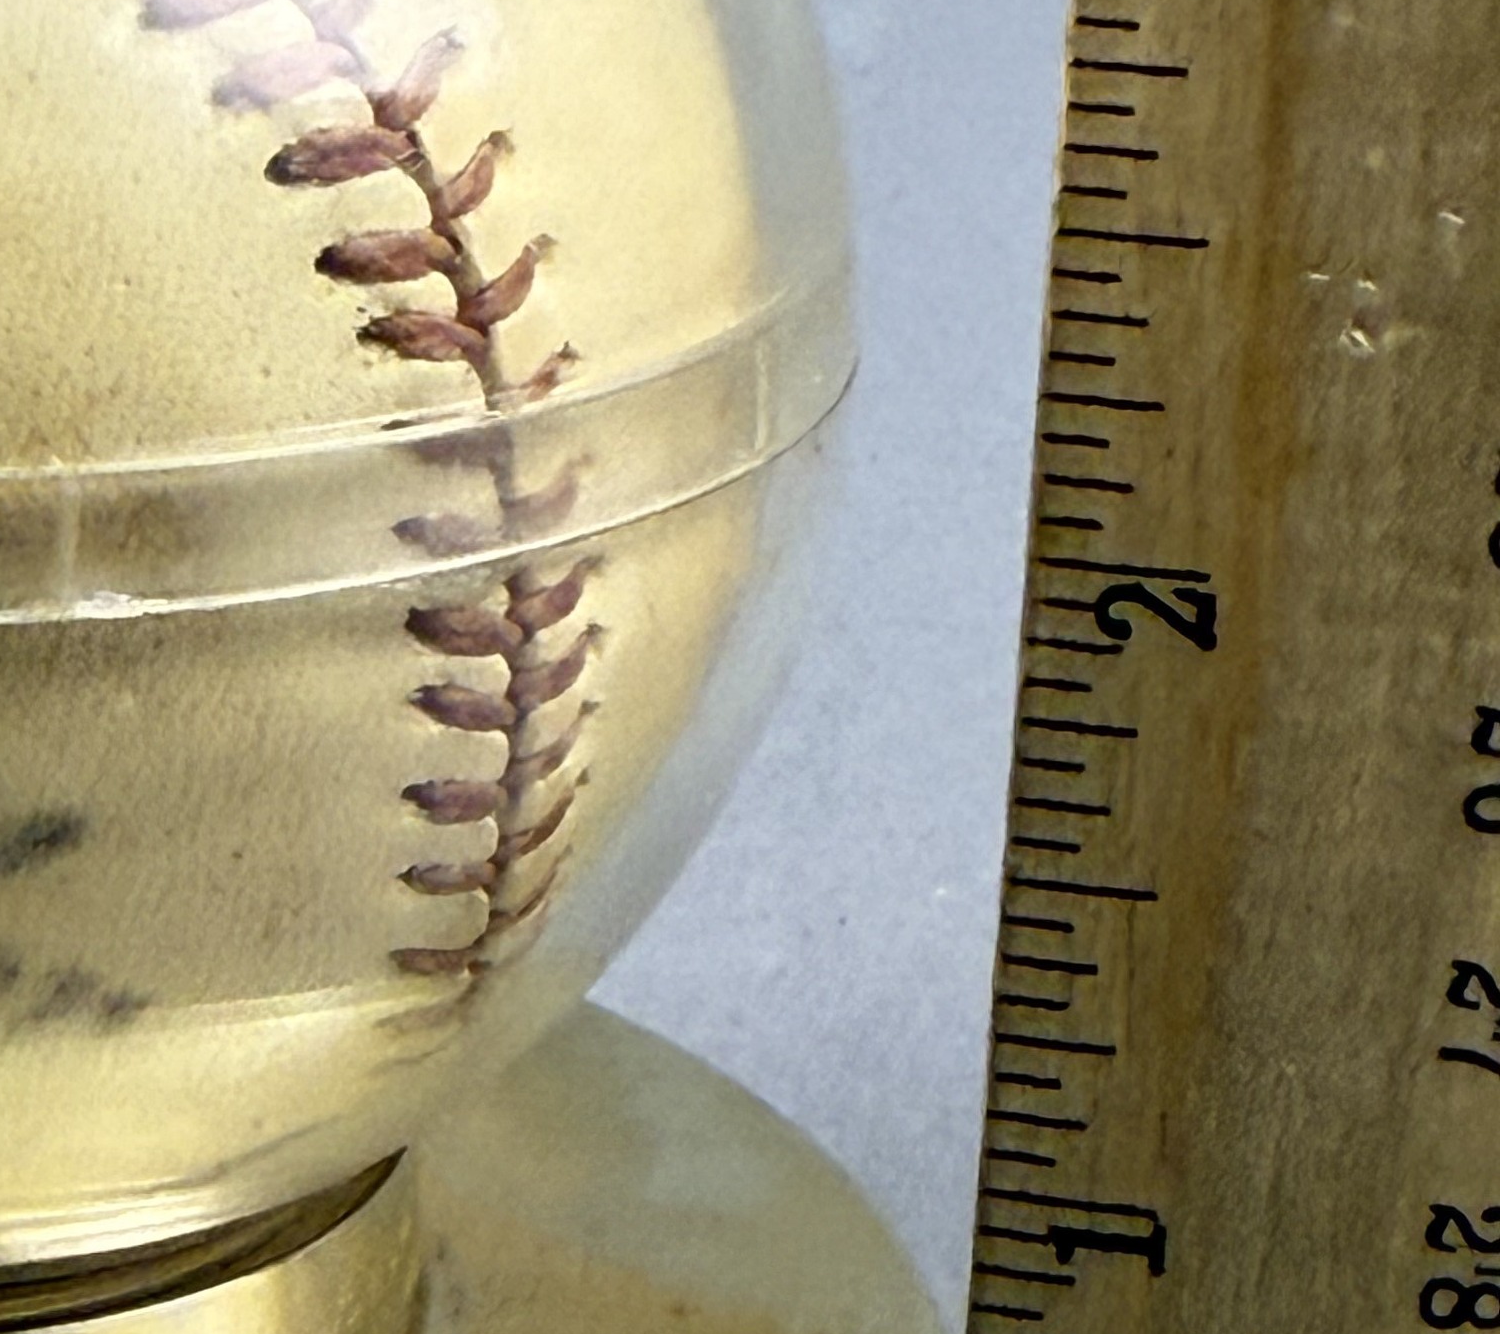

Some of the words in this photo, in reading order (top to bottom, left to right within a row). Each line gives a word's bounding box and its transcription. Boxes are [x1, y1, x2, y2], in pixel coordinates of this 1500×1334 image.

[1093, 582, 1217, 652] 2
[1047, 1223, 1167, 1277] 1
[1418, 1203, 1500, 1329] 28
